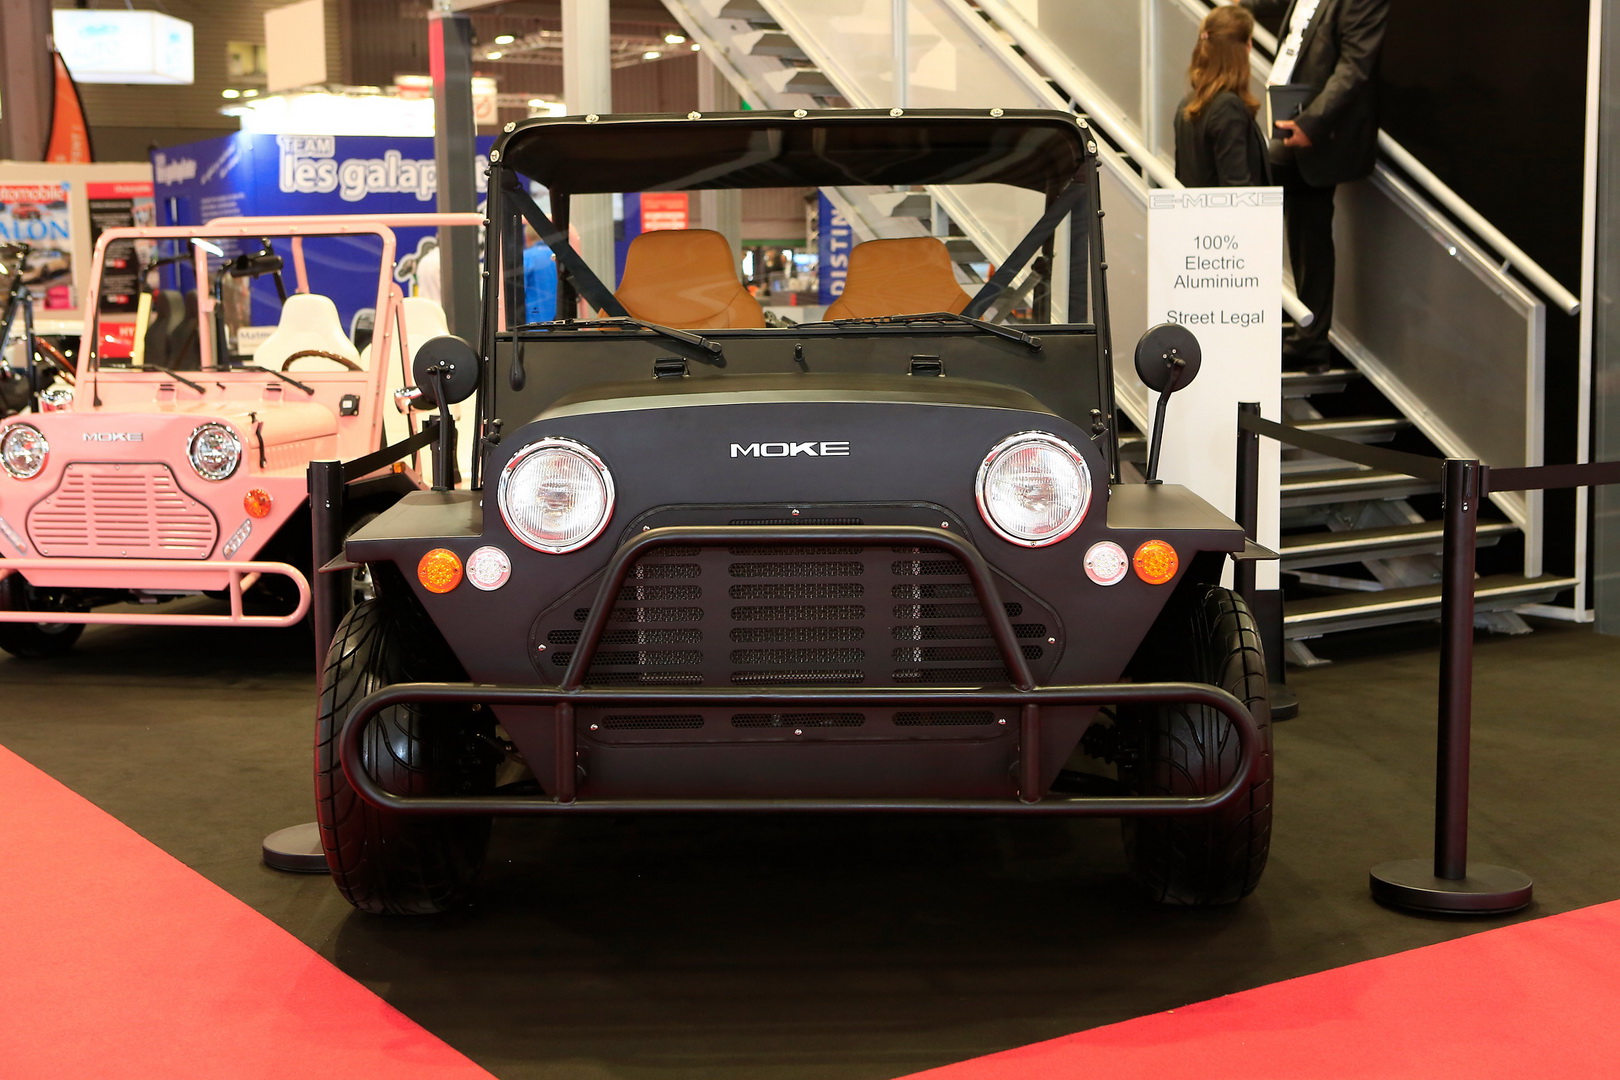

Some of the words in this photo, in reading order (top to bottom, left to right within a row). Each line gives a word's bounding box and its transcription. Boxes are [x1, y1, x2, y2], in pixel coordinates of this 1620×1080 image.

[280, 136, 331, 154] TEAM
[282, 153, 336, 190] les
[1149, 191, 1283, 209] E-MOKE
[0, 218, 69, 240] ALON
[1194, 235, 1239, 250] 100%
[830, 209, 849, 296] DISTIN
[1185, 255, 1245, 270] Electric
[1174, 274, 1259, 289] Aluminium
[1166, 310, 1215, 324] Street
[1221, 310, 1264, 327] Legal
[83, 432, 144, 442] MOKE
[730, 441, 850, 458] MOKE
